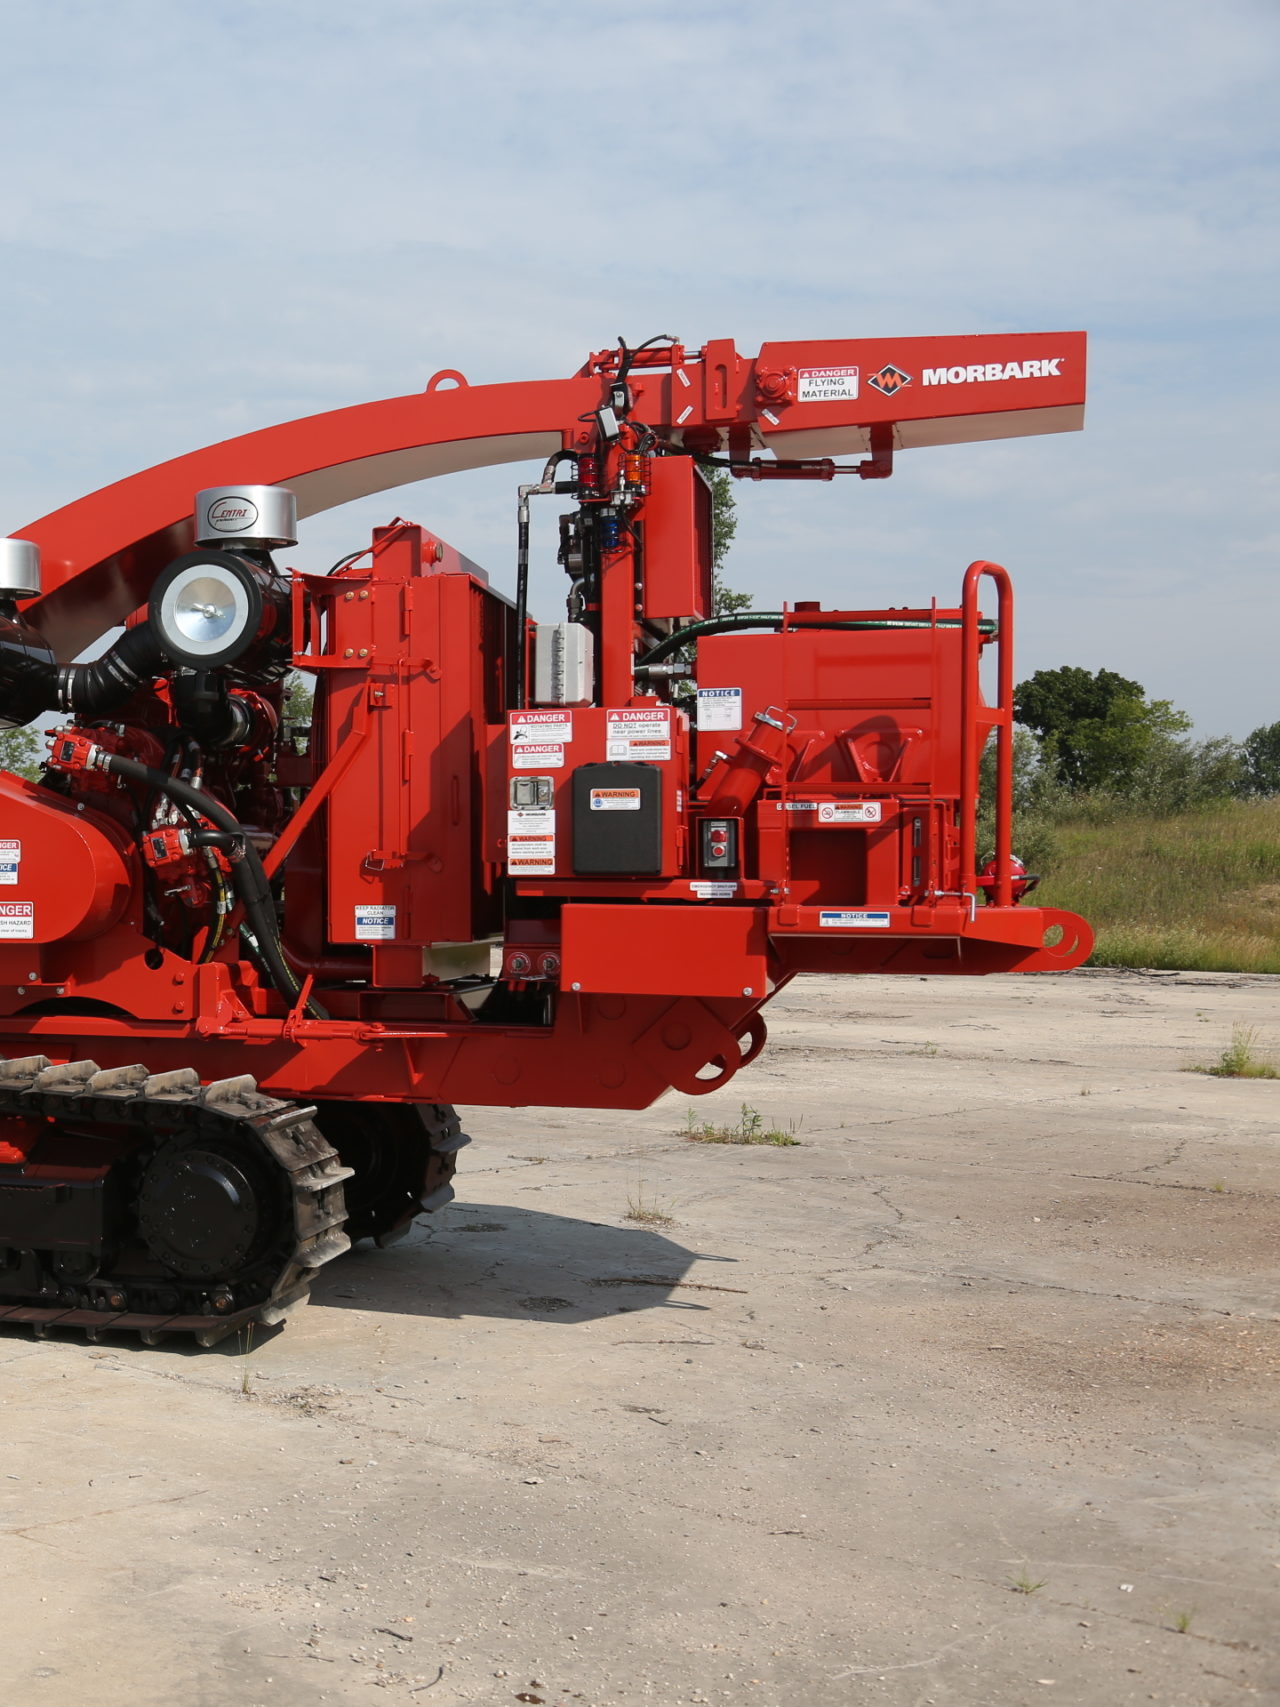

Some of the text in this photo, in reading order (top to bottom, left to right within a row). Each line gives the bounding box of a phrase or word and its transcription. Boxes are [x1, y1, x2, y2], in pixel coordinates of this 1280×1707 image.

[811, 369, 855, 377] DANGER
[922, 358, 1062, 386] MORBARK
[808, 378, 845, 387] FLYING
[802, 389, 854, 398] MATERIAL
[526, 714, 565, 723] DANGER
[622, 711, 664, 721] DANGER
[523, 745, 560, 753] DANGER
[362, 917, 389, 925] NOTICE
